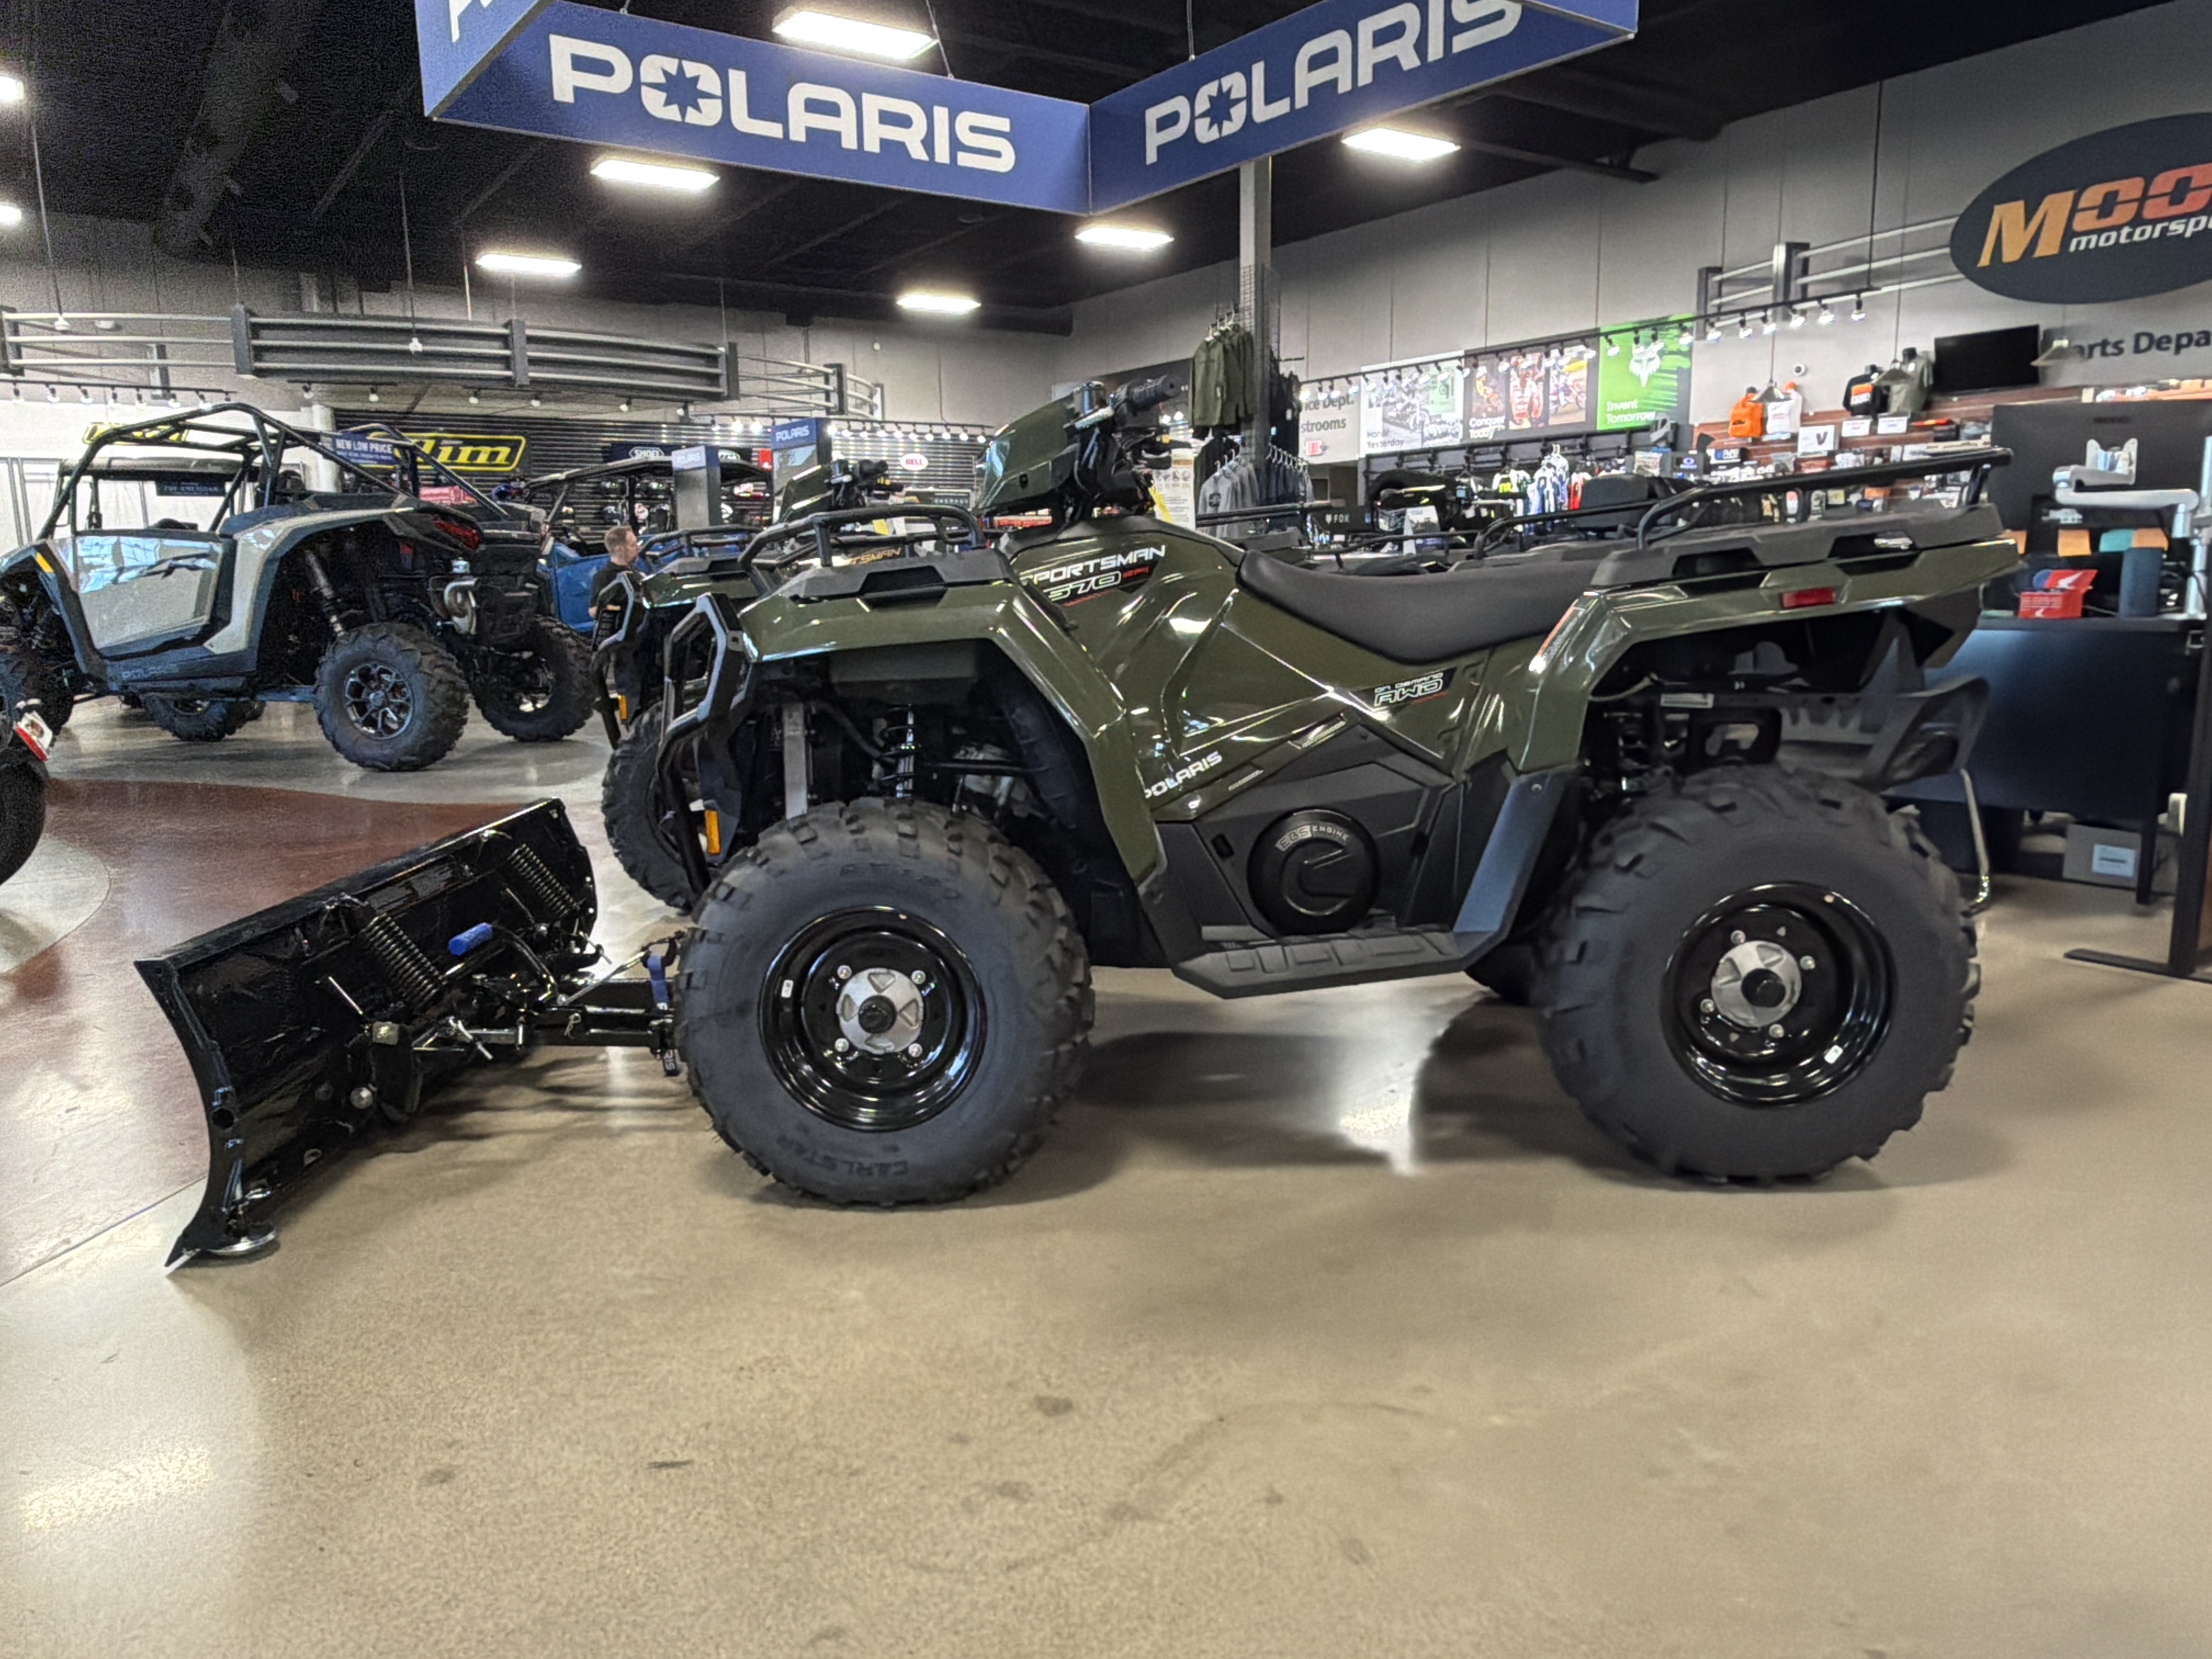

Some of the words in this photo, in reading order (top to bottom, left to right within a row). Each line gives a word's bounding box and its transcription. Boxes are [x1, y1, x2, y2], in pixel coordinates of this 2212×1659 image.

[1145, 0, 1522, 166] POLARIS
[549, 34, 1015, 173] POLARIS
[1977, 162, 2212, 268] MOO
[2069, 215, 2212, 252] motorsp
[1606, 399, 1638, 412] Invent
[1606, 410, 1656, 425] Tomorrow
[776, 426, 809, 441] POLARIS
[1469, 415, 1505, 428] Conquer
[335, 438, 352, 449] NEW
[353, 441, 369, 451] LOW
[370, 442, 393, 453] PRICE
[1019, 544, 1166, 585] SPORTSMAN
[1374, 678, 1443, 707] AWD
